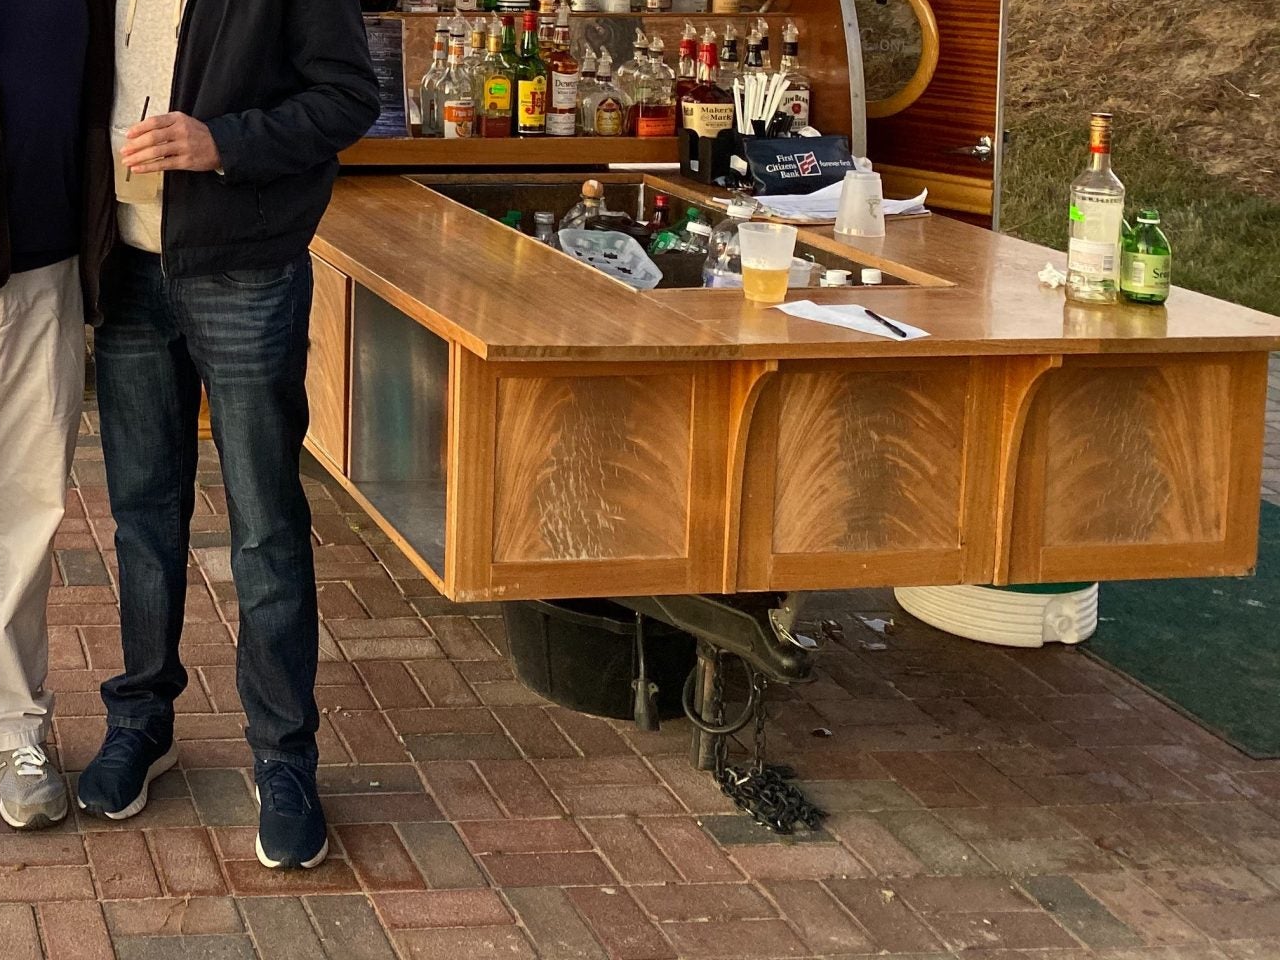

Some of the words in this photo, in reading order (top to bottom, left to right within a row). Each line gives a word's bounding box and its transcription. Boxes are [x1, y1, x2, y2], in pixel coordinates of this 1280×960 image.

[701, 106, 733, 114] Maker's
[710, 113, 732, 121] Mark
[776, 154, 794, 163] First
[765, 163, 798, 173] Citizens
[780, 169, 800, 179] Bank
